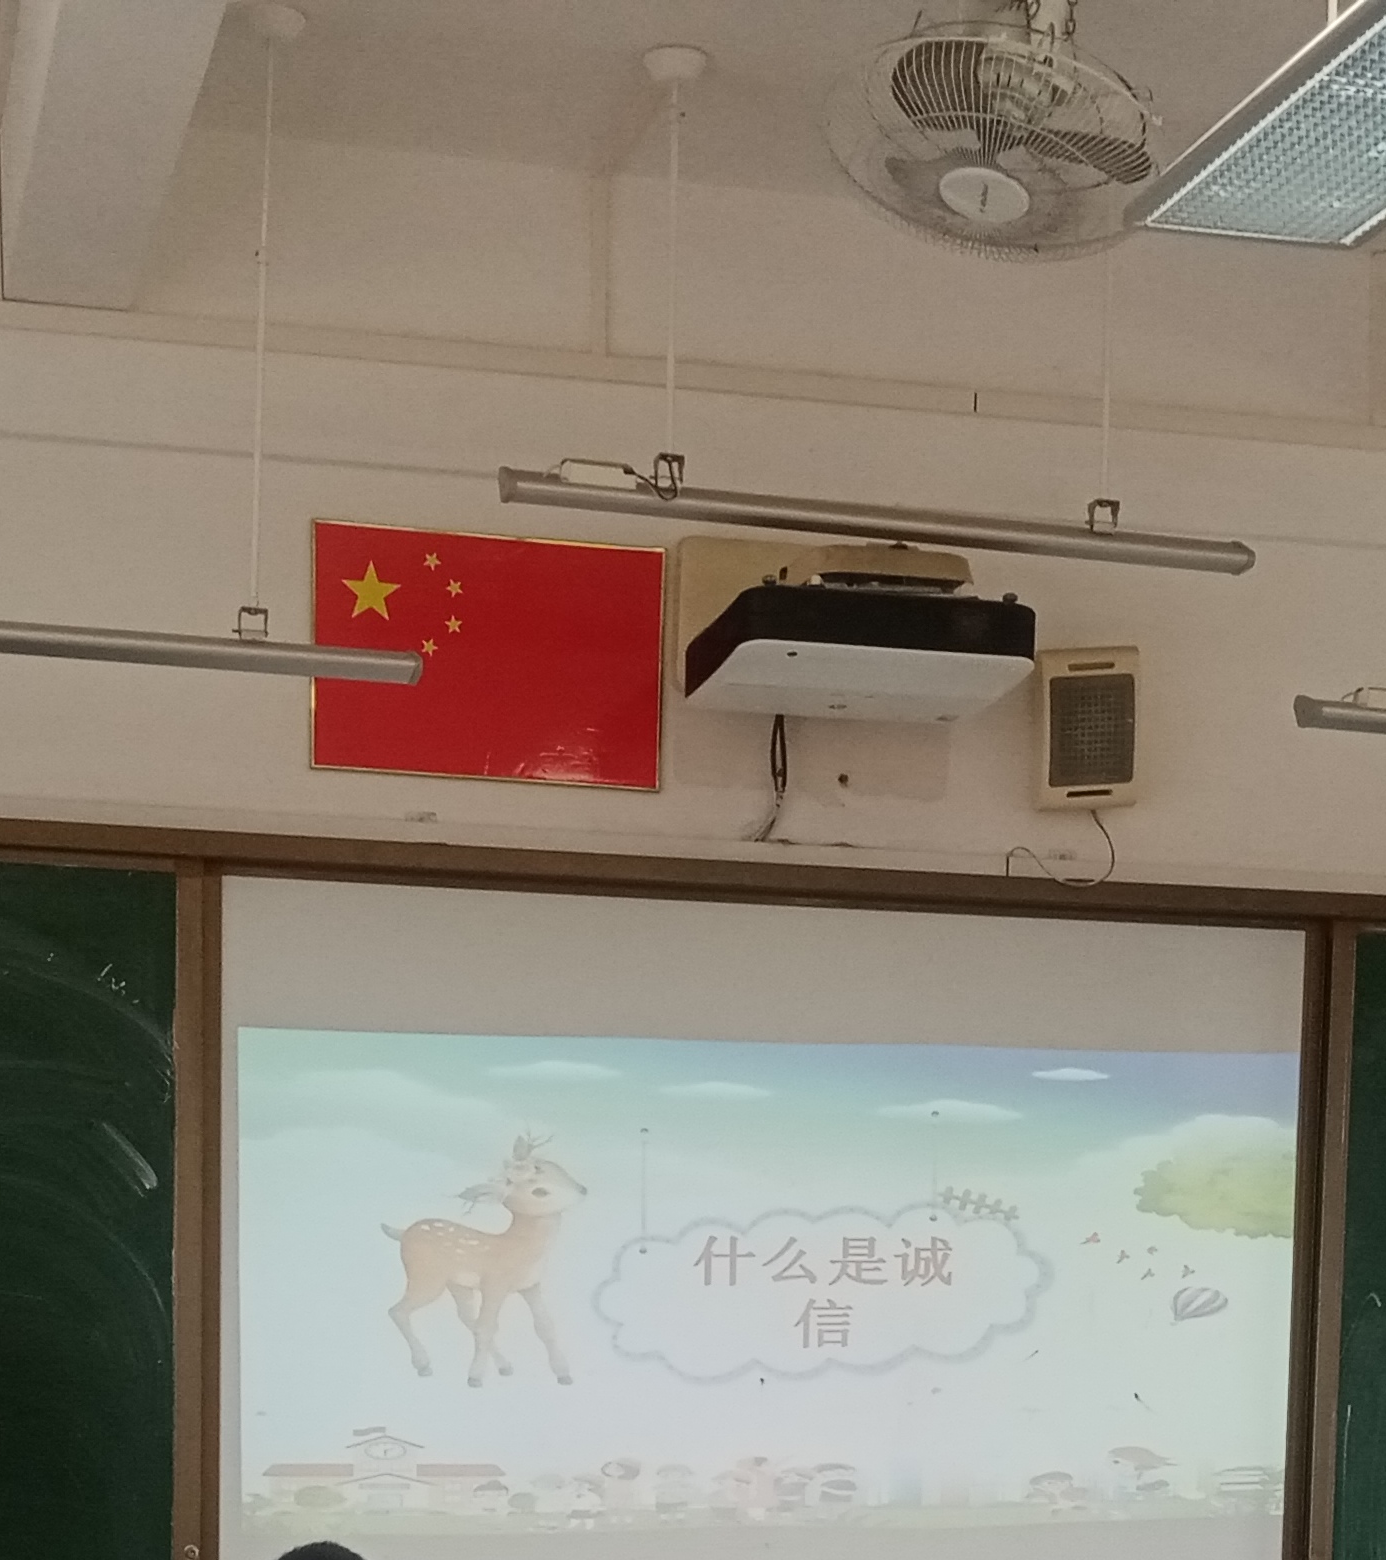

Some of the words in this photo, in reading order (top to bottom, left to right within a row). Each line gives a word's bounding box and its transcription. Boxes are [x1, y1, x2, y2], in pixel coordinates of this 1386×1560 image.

[693, 1235, 953, 1287] 什么是诚
[793, 1298, 854, 1349] 信
